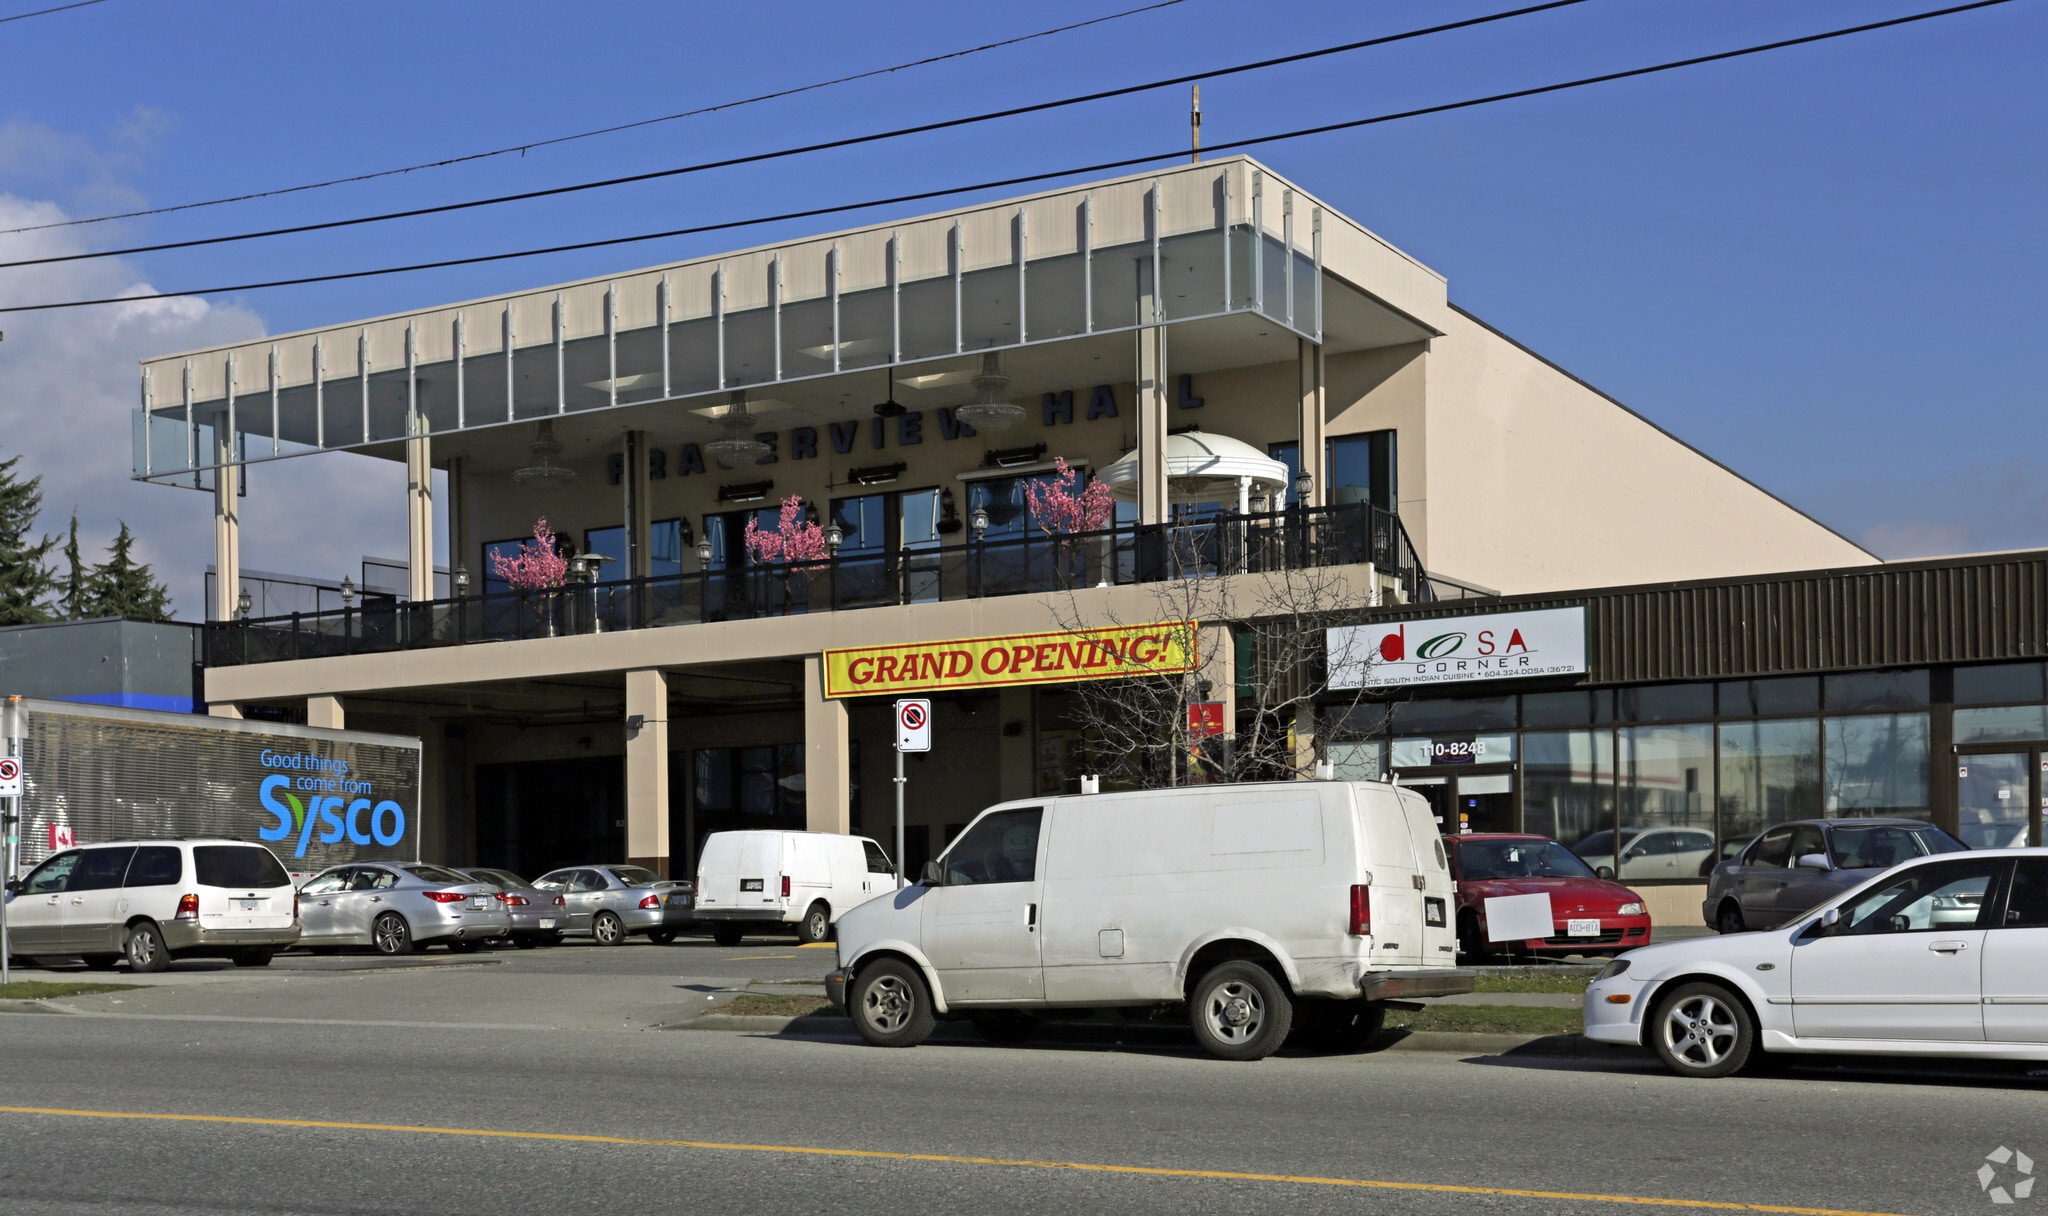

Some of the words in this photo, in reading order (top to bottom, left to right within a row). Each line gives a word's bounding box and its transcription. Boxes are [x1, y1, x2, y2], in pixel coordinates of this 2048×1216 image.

[607, 406, 978, 485] FRAERVIEW
[1043, 374, 1204, 426] HAL
[848, 650, 973, 685] GRAND
[980, 634, 1171, 675] OPENING!
[1416, 656, 1529, 674] CORNER
[1384, 676, 1411, 685] SOUTH
[1413, 674, 1440, 682] INDIAN
[1442, 672, 1475, 681] CUISINE
[1547, 664, 1575, 673] (3672)
[1421, 741, 1486, 757] 110-8248
[260, 749, 301, 769] Good
[304, 753, 349, 776] things
[296, 776, 336, 792] come
[339, 775, 372, 794] from
